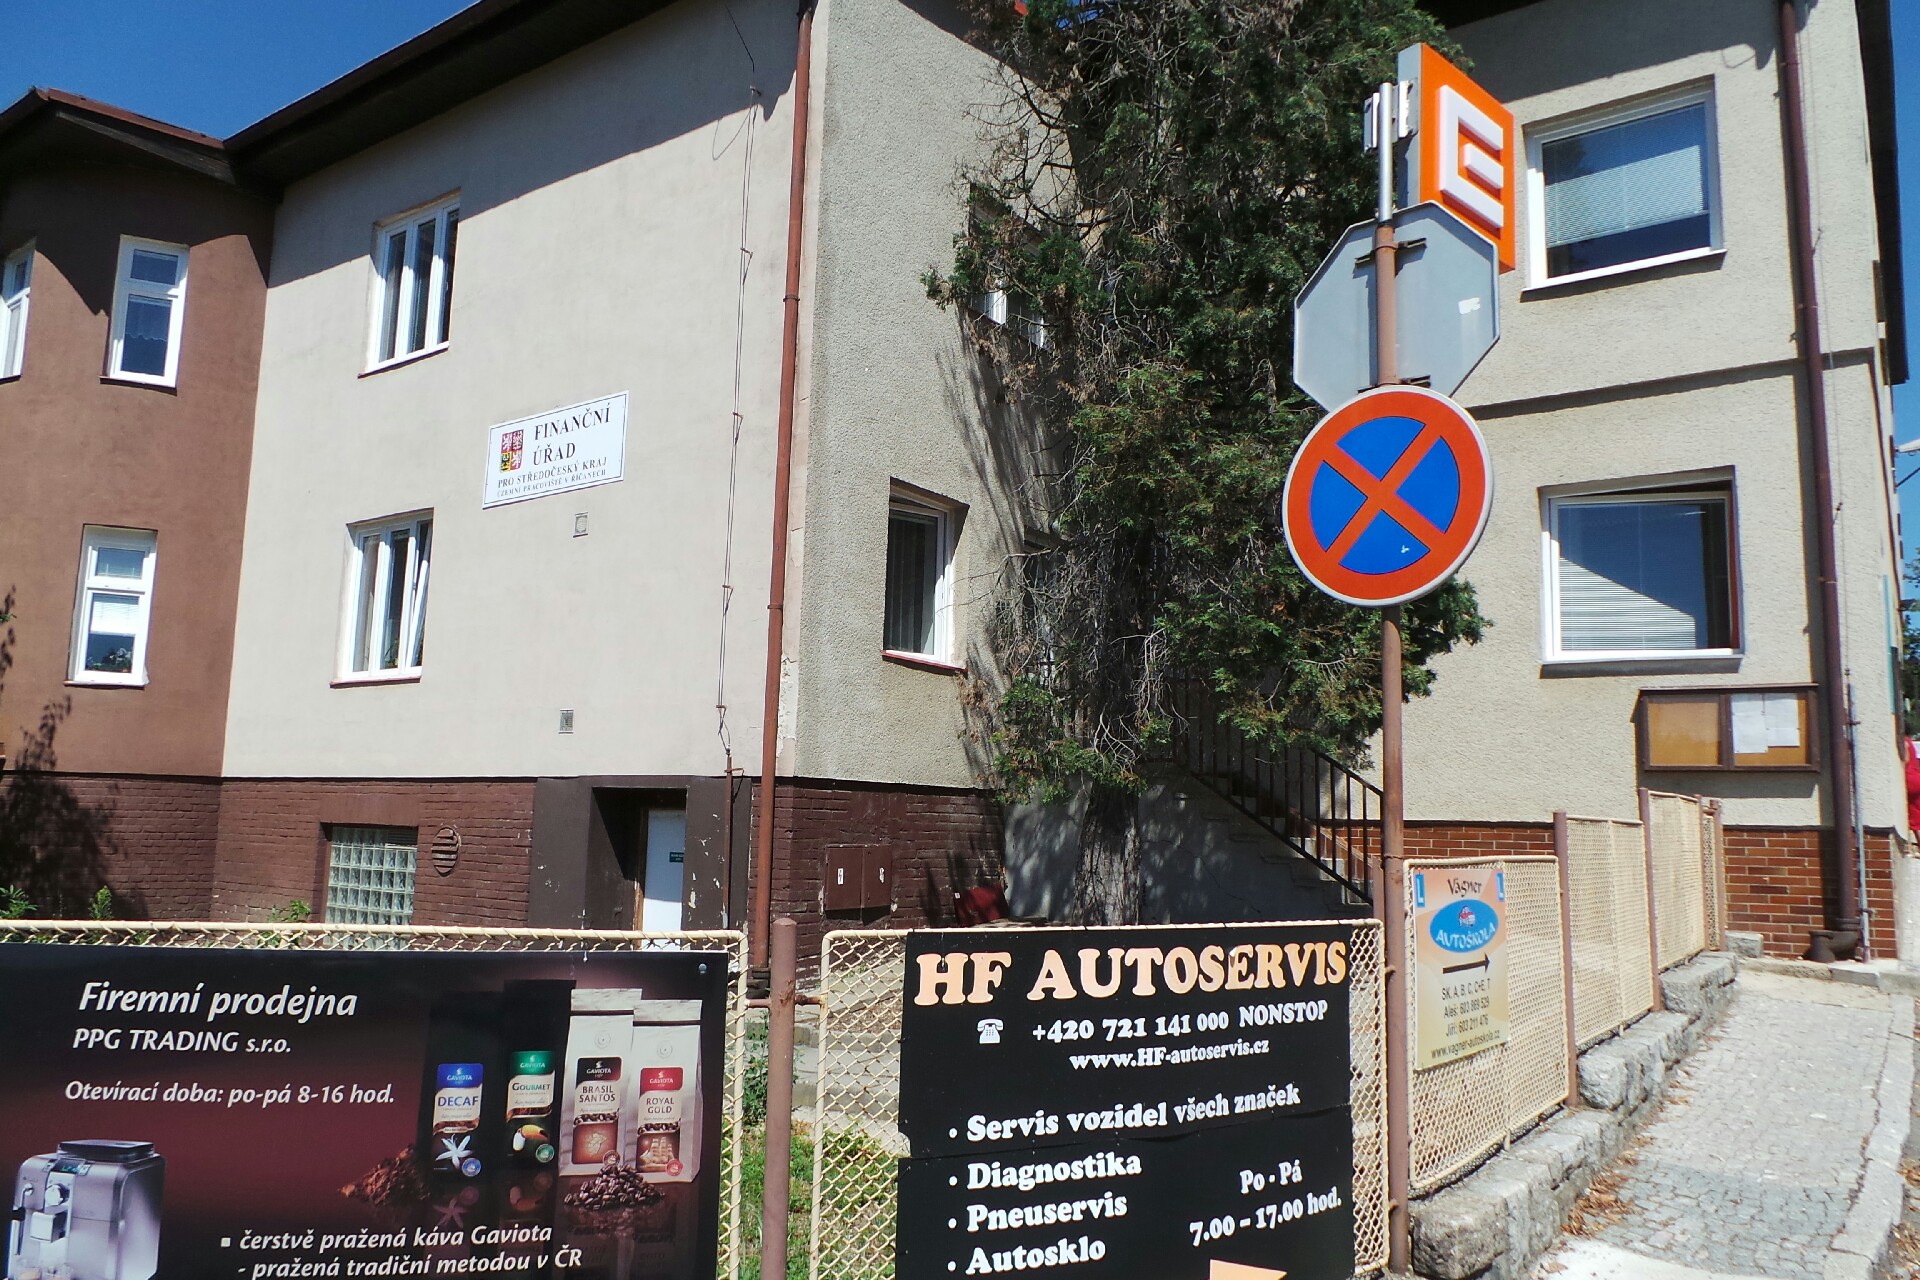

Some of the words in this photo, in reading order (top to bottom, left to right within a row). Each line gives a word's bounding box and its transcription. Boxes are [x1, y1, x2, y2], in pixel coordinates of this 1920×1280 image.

[534, 402, 611, 441] FINANČNÍ
[533, 442, 576, 466] ÚŘAD
[498, 478, 514, 488] PRO
[517, 460, 579, 485] STŘEDOČESKÝ
[582, 457, 607, 470] KRAJ
[1447, 877, 1482, 897] Vágner
[1436, 922, 1496, 949] AUTOŠKOLA
[913, 952, 1013, 1006] HF
[1026, 941, 1347, 1000] AUTOSERVIS
[78, 981, 205, 1013] Firemní
[207, 984, 358, 1024] prodejna
[1032, 1018, 1095, 1043] +420
[1102, 1016, 1147, 1041] 721
[1155, 1014, 1190, 1037] 141
[1196, 1011, 1229, 1033] 000
[1238, 1000, 1328, 1029] NONSTOP
[72, 1028, 121, 1050] PPG
[129, 1029, 239, 1052] TRADING
[245, 1036, 292, 1053] s.r.o.
[1069, 1038, 1270, 1071] www.HF-autoservis.cz
[65, 1080, 159, 1102] Otevírací
[163, 1082, 224, 1103] doba:
[227, 1083, 292, 1108] po-pá
[298, 1085, 344, 1104] 8-16
[349, 1083, 395, 1104] hod.
[437, 1096, 479, 1107] DECAF
[579, 1093, 616, 1103] SANTOS
[582, 1085, 614, 1094] BRASIL
[646, 1097, 675, 1105] ROYAL
[647, 1106, 672, 1114] GOLD
[966, 1110, 1059, 1142] Servis
[1065, 1101, 1168, 1133] vozidel
[1174, 1093, 1230, 1123] všech
[1234, 1083, 1301, 1114] značek
[967, 1152, 1142, 1193] Diagnostika
[1239, 1169, 1264, 1195] Po
[1279, 1159, 1303, 1186] Pá
[966, 1192, 1128, 1232] Pneuservis
[1189, 1212, 1235, 1247] 7.00
[1254, 1198, 1304, 1228] 17.00
[1306, 1186, 1342, 1216] hod.
[239, 1229, 315, 1250] čerstvě
[320, 1226, 406, 1253] pražená
[414, 1226, 464, 1246] káva
[471, 1224, 553, 1245] Gaviota
[251, 1256, 340, 1280] pražená
[346, 1253, 431, 1276] tradiční
[436, 1251, 530, 1273] metodou
[535, 1254, 549, 1269] v
[554, 1244, 583, 1268] ČR
[965, 1235, 1106, 1276] Autosklo
